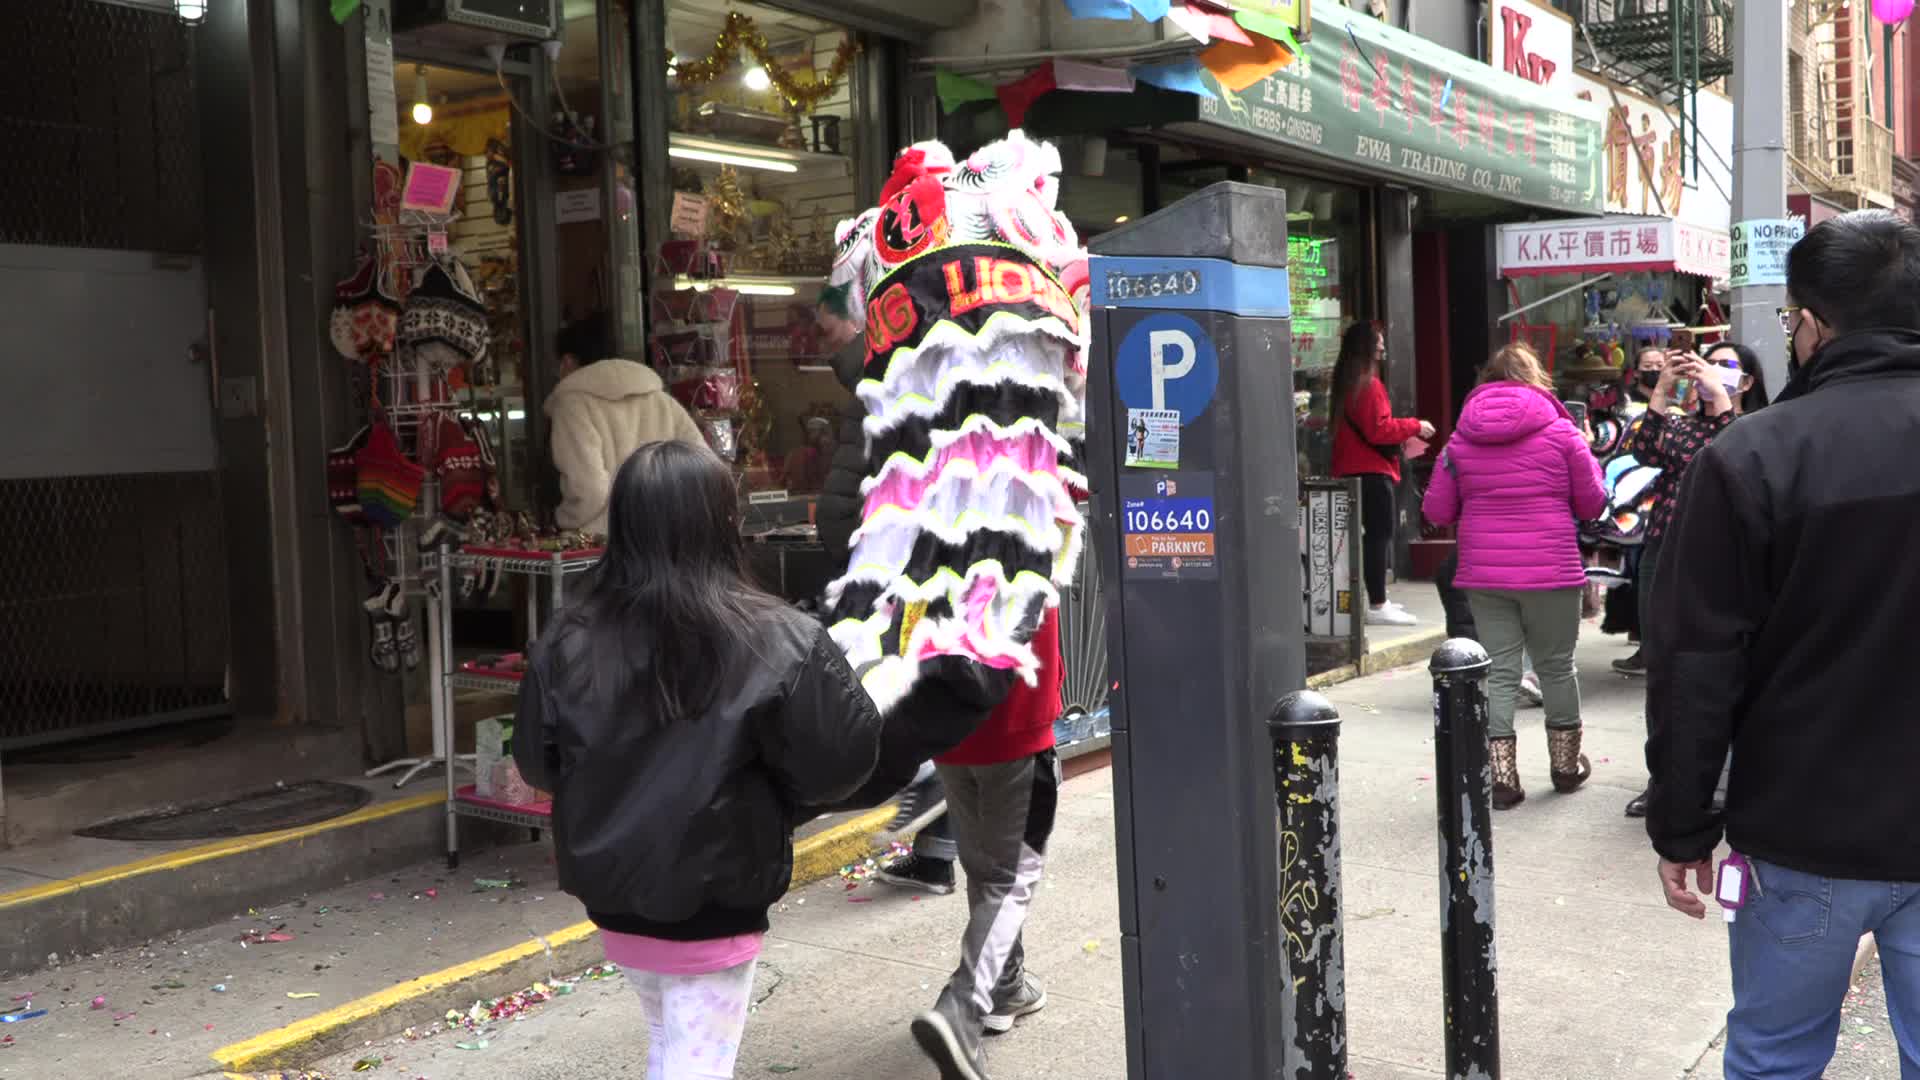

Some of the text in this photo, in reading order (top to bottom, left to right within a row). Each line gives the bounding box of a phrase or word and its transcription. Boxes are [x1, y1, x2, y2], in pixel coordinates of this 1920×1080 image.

[1251, 105, 1322, 145] HERBS GINSENG
[1356, 135, 1392, 162] EWA
[1401, 147, 1466, 181] TRADING
[1754, 225, 1772, 239] NO
[1107, 271, 1197, 300] 106640
[1149, 329, 1196, 411] P
[1127, 509, 1209, 531] 106640
[1151, 541, 1206, 554] PARKNYC
